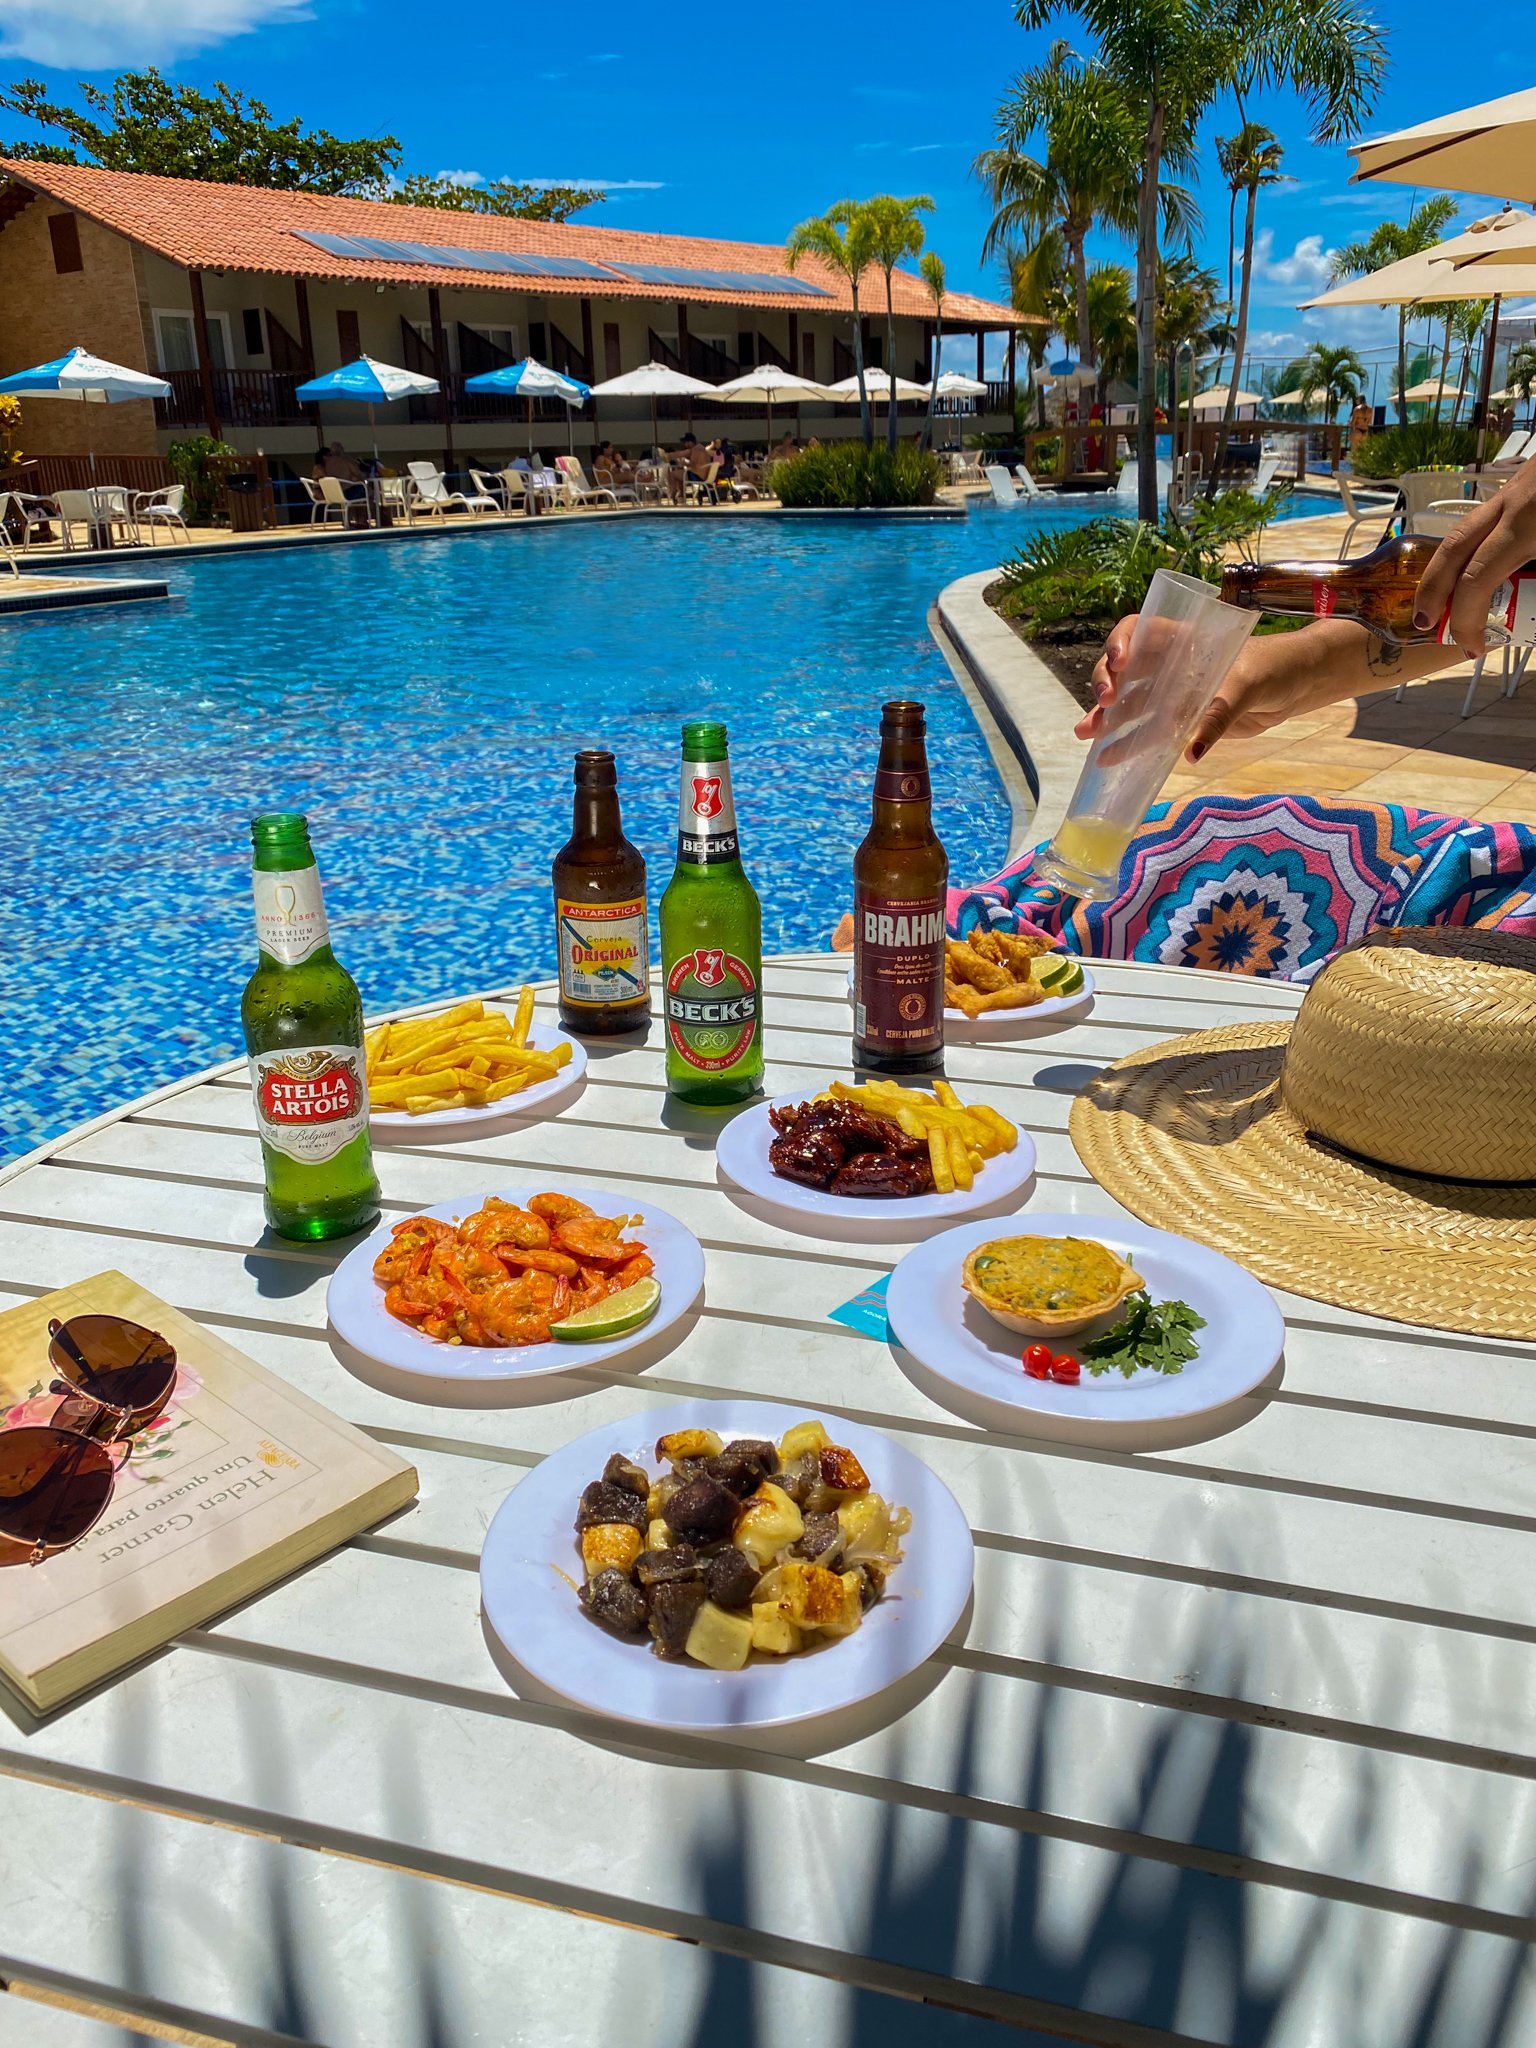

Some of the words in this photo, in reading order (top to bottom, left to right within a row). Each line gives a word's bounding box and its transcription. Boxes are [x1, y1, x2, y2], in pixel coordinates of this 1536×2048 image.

[682, 836, 736, 853] BECK'S
[568, 905, 638, 918] ANTARCTICA
[266, 927, 313, 938] PREMIUM
[571, 945, 639, 965] ORIGINAL
[896, 953, 931, 962] DUPLO
[671, 963, 690, 987] BREMEN
[729, 961, 752, 988] GERMANY
[896, 977, 931, 985] MALTE
[669, 996, 756, 1022] BECK'S
[885, 1029, 908, 1039] CERVEJA
[673, 1031, 685, 1051] PURE
[685, 1051, 701, 1065] MALT
[725, 1045, 743, 1064] PURITY
[284, 1069, 304, 1081] ANNO
[271, 1078, 348, 1099] STELLA
[272, 1093, 350, 1116] ARTOIS
[287, 1128, 337, 1144] Belgium
[213, 1455, 253, 1476] Um
[145, 1475, 209, 1511] quarto
[198, 1468, 278, 1511] Helen
[93, 1508, 140, 1539] para
[99, 1513, 194, 1564] Garner
